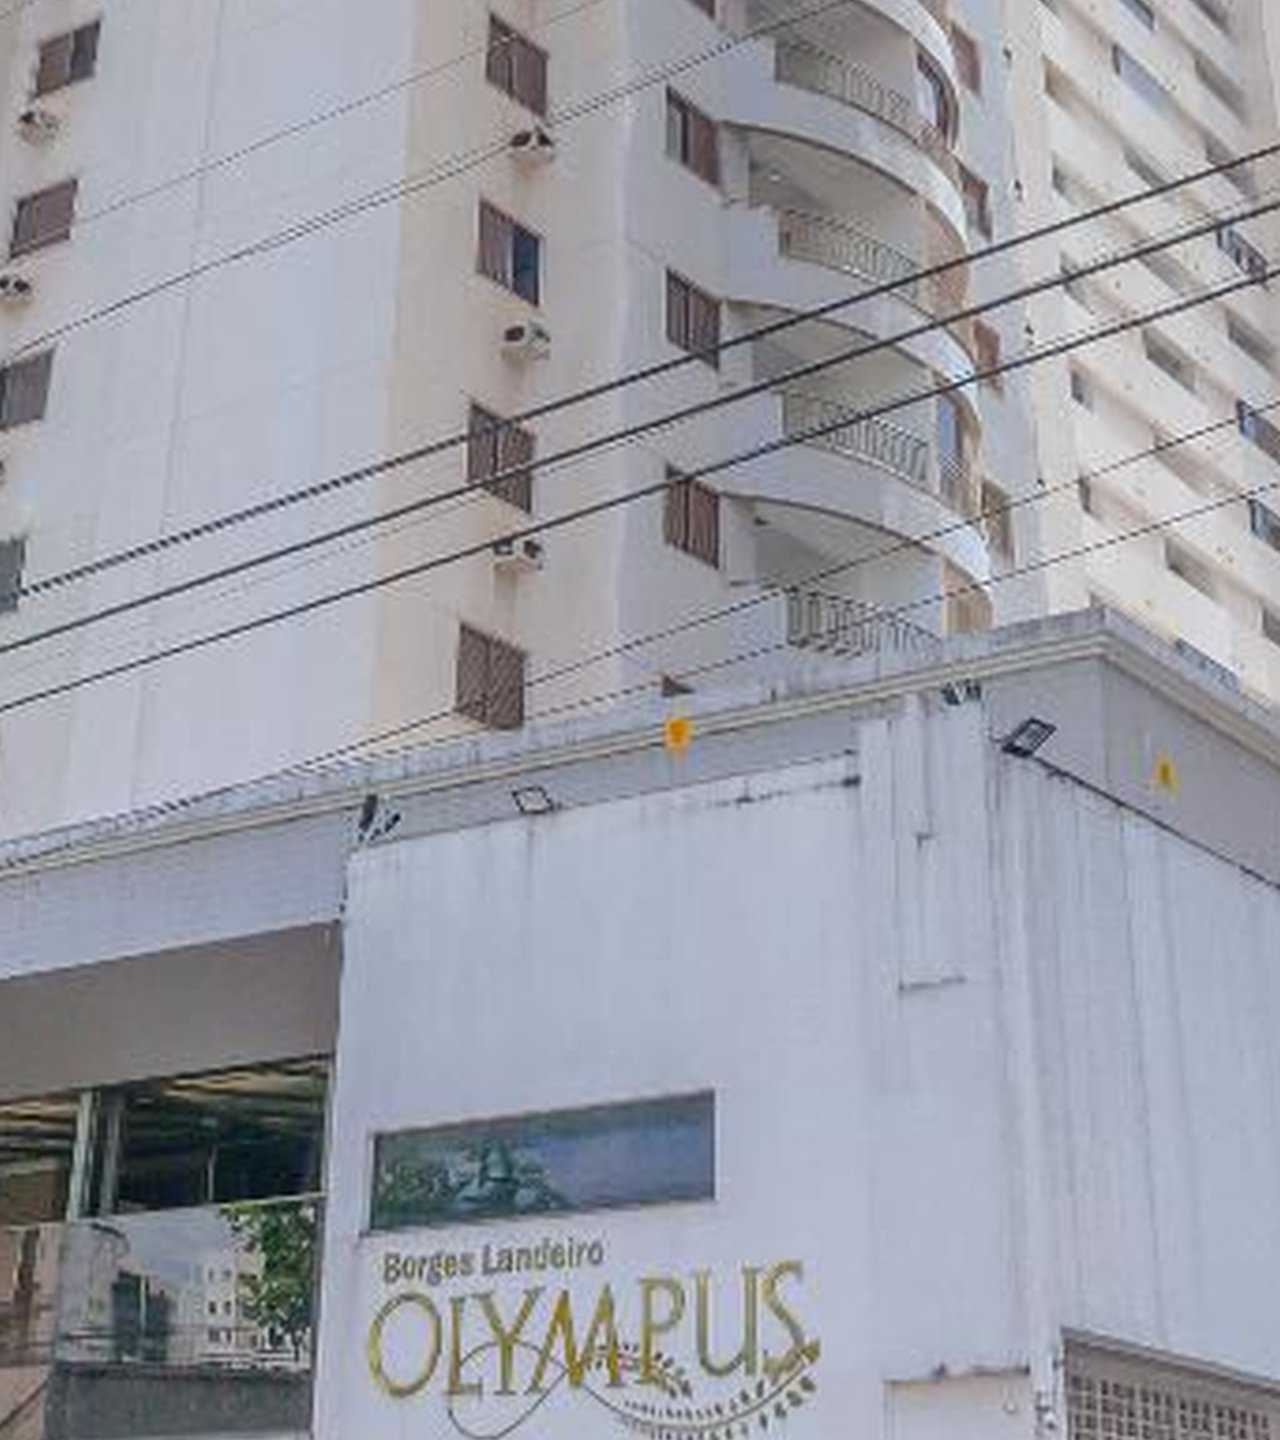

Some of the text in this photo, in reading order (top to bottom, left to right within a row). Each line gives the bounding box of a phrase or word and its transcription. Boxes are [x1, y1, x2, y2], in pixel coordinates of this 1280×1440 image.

[383, 1237, 604, 1285] Borges Landeiro
[367, 1258, 817, 1398] OLYMPUS
